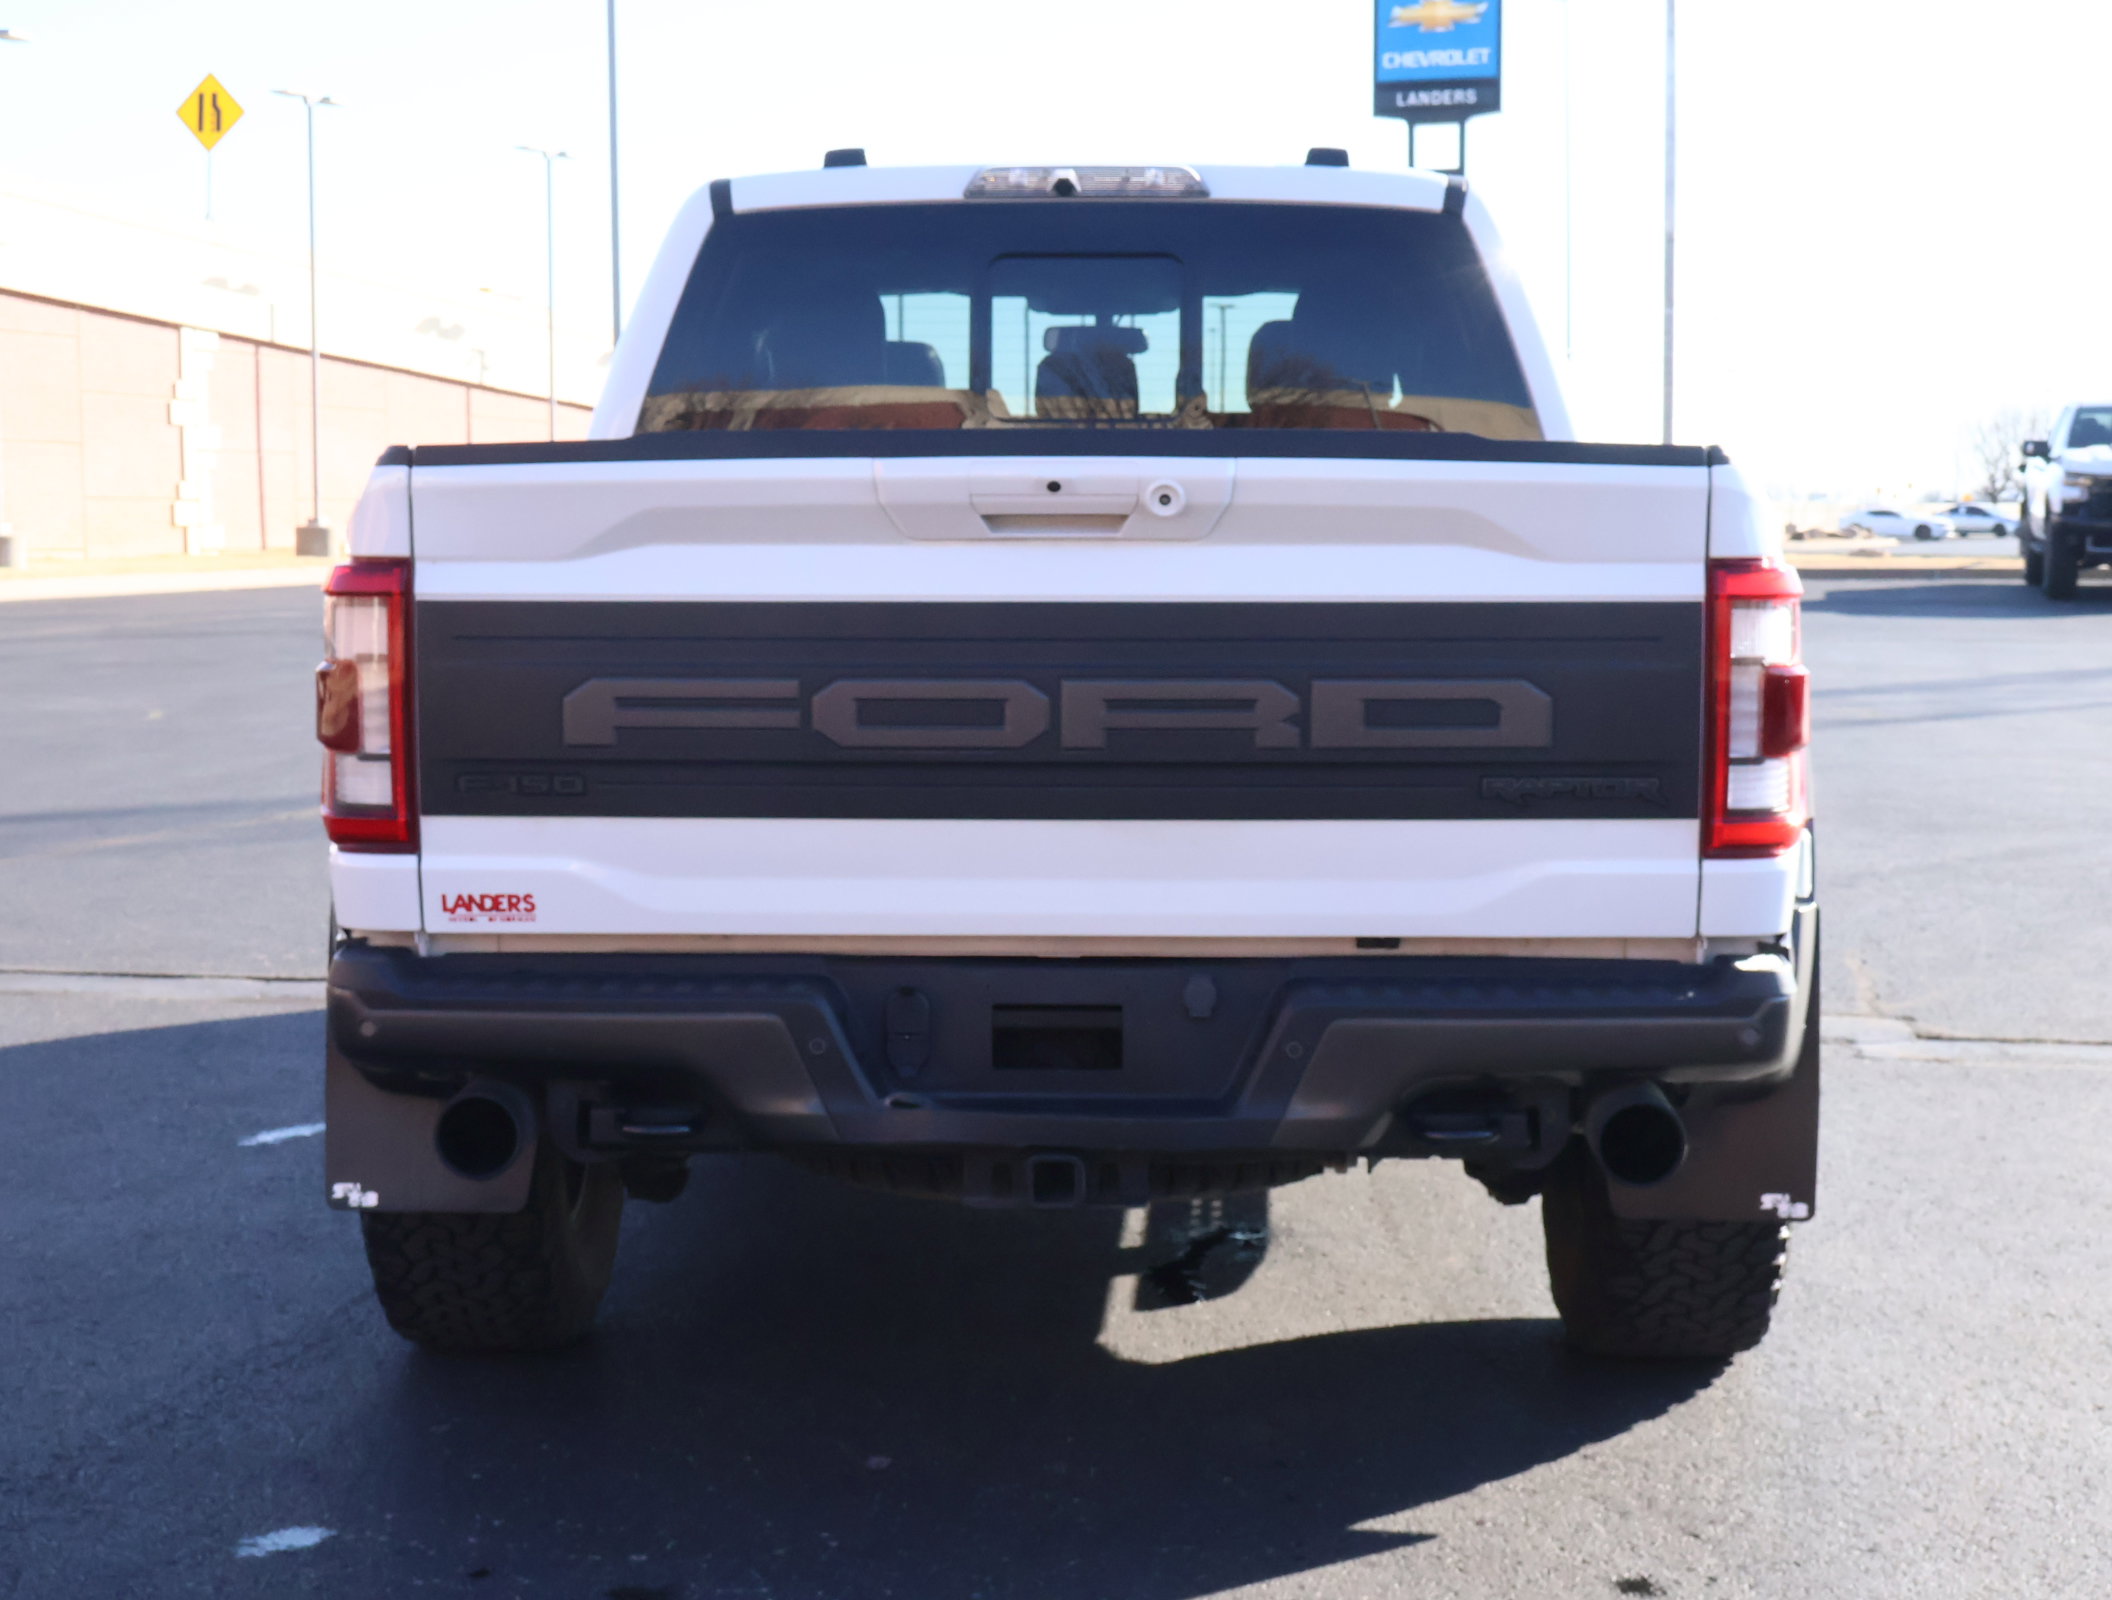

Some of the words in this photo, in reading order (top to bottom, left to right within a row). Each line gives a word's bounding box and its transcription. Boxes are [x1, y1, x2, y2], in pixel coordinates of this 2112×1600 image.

[1382, 47, 1491, 69] CHEVROLET
[1396, 88, 1477, 107] LANDERS
[562, 678, 1553, 749] FORD
[1481, 776, 1667, 807] RAPTOR
[441, 893, 536, 914] LANDERS
